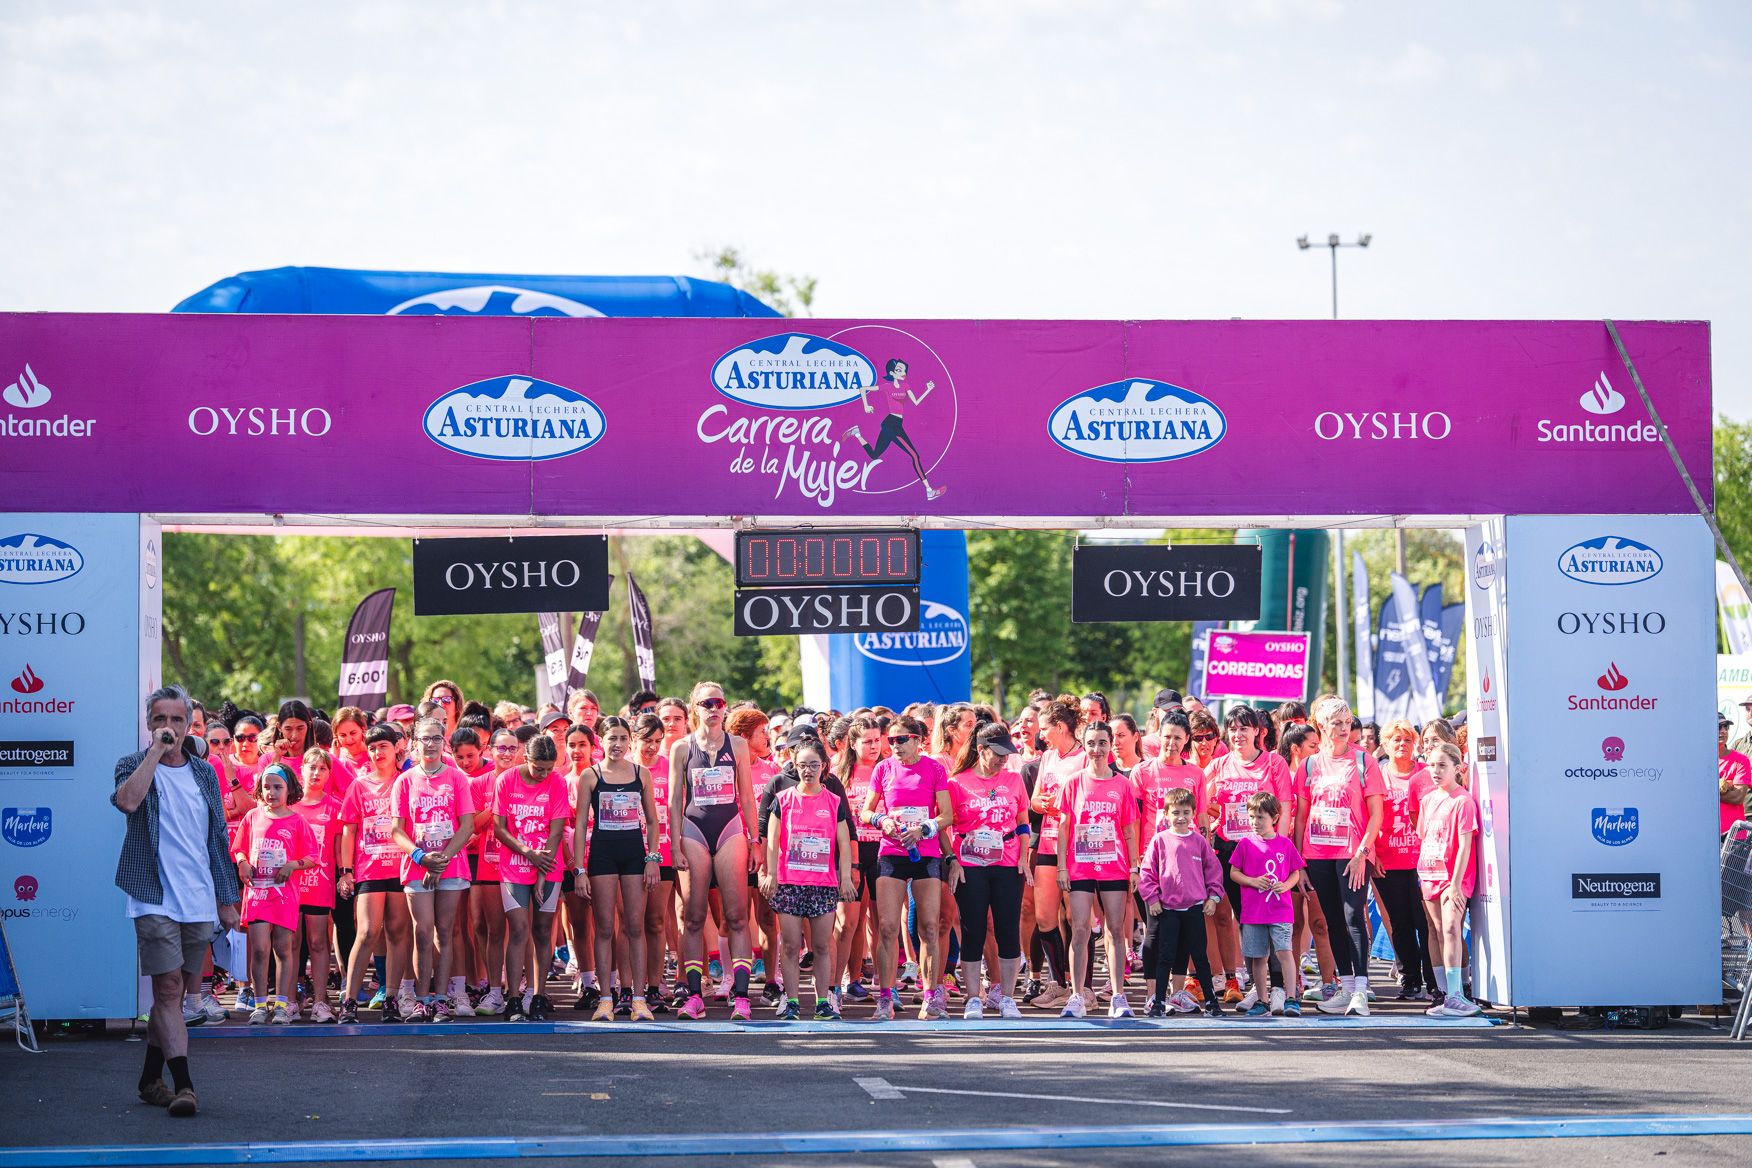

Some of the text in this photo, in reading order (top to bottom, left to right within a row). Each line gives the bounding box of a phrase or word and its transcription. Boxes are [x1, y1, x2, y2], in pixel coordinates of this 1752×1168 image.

[750, 359, 859, 367] CENTRAL LECHERA
[724, 360, 864, 390] ASTURIANA
[465, 404, 587, 414] CENTRAL LECHERA
[1089, 407, 1208, 416] CENTRAL LECHERA
[187, 406, 332, 437] OYSHO
[437, 405, 593, 440] ASTURIANA
[696, 404, 833, 445] Carrera
[1061, 409, 1213, 441] ASTURIANA
[1314, 410, 1452, 440] OYSHO
[729, 440, 883, 507] de la Mujer
[1566, 553, 1656, 573] ASTURIANA
[445, 559, 580, 591] OYSHO
[1103, 568, 1236, 598] OYSHO
[743, 592, 912, 630] OYSHO
[1557, 611, 1666, 635] OYSHO
[351, 631, 387, 644] OYSHO
[863, 630, 964, 649] ASTURIANA
[1265, 641, 1305, 653] OYSHO
[1208, 660, 1304, 679] CORREDORAS
[1719, 668, 1752, 682] AMB
[1567, 695, 1658, 711] Santander
[1564, 767, 1664, 781] octopus energy
[4, 815, 49, 837] Marlene
[1321, 824, 1336, 832] 016
[1594, 815, 1637, 836] Marlene
[426, 840, 443, 848] 016
[973, 847, 991, 855] 016
[1088, 841, 1104, 849] 016
[801, 851, 818, 859] 016
[258, 867, 273, 875] 016
[1577, 878, 1656, 895] Neutrogena
[31, 907, 79, 921] energy
